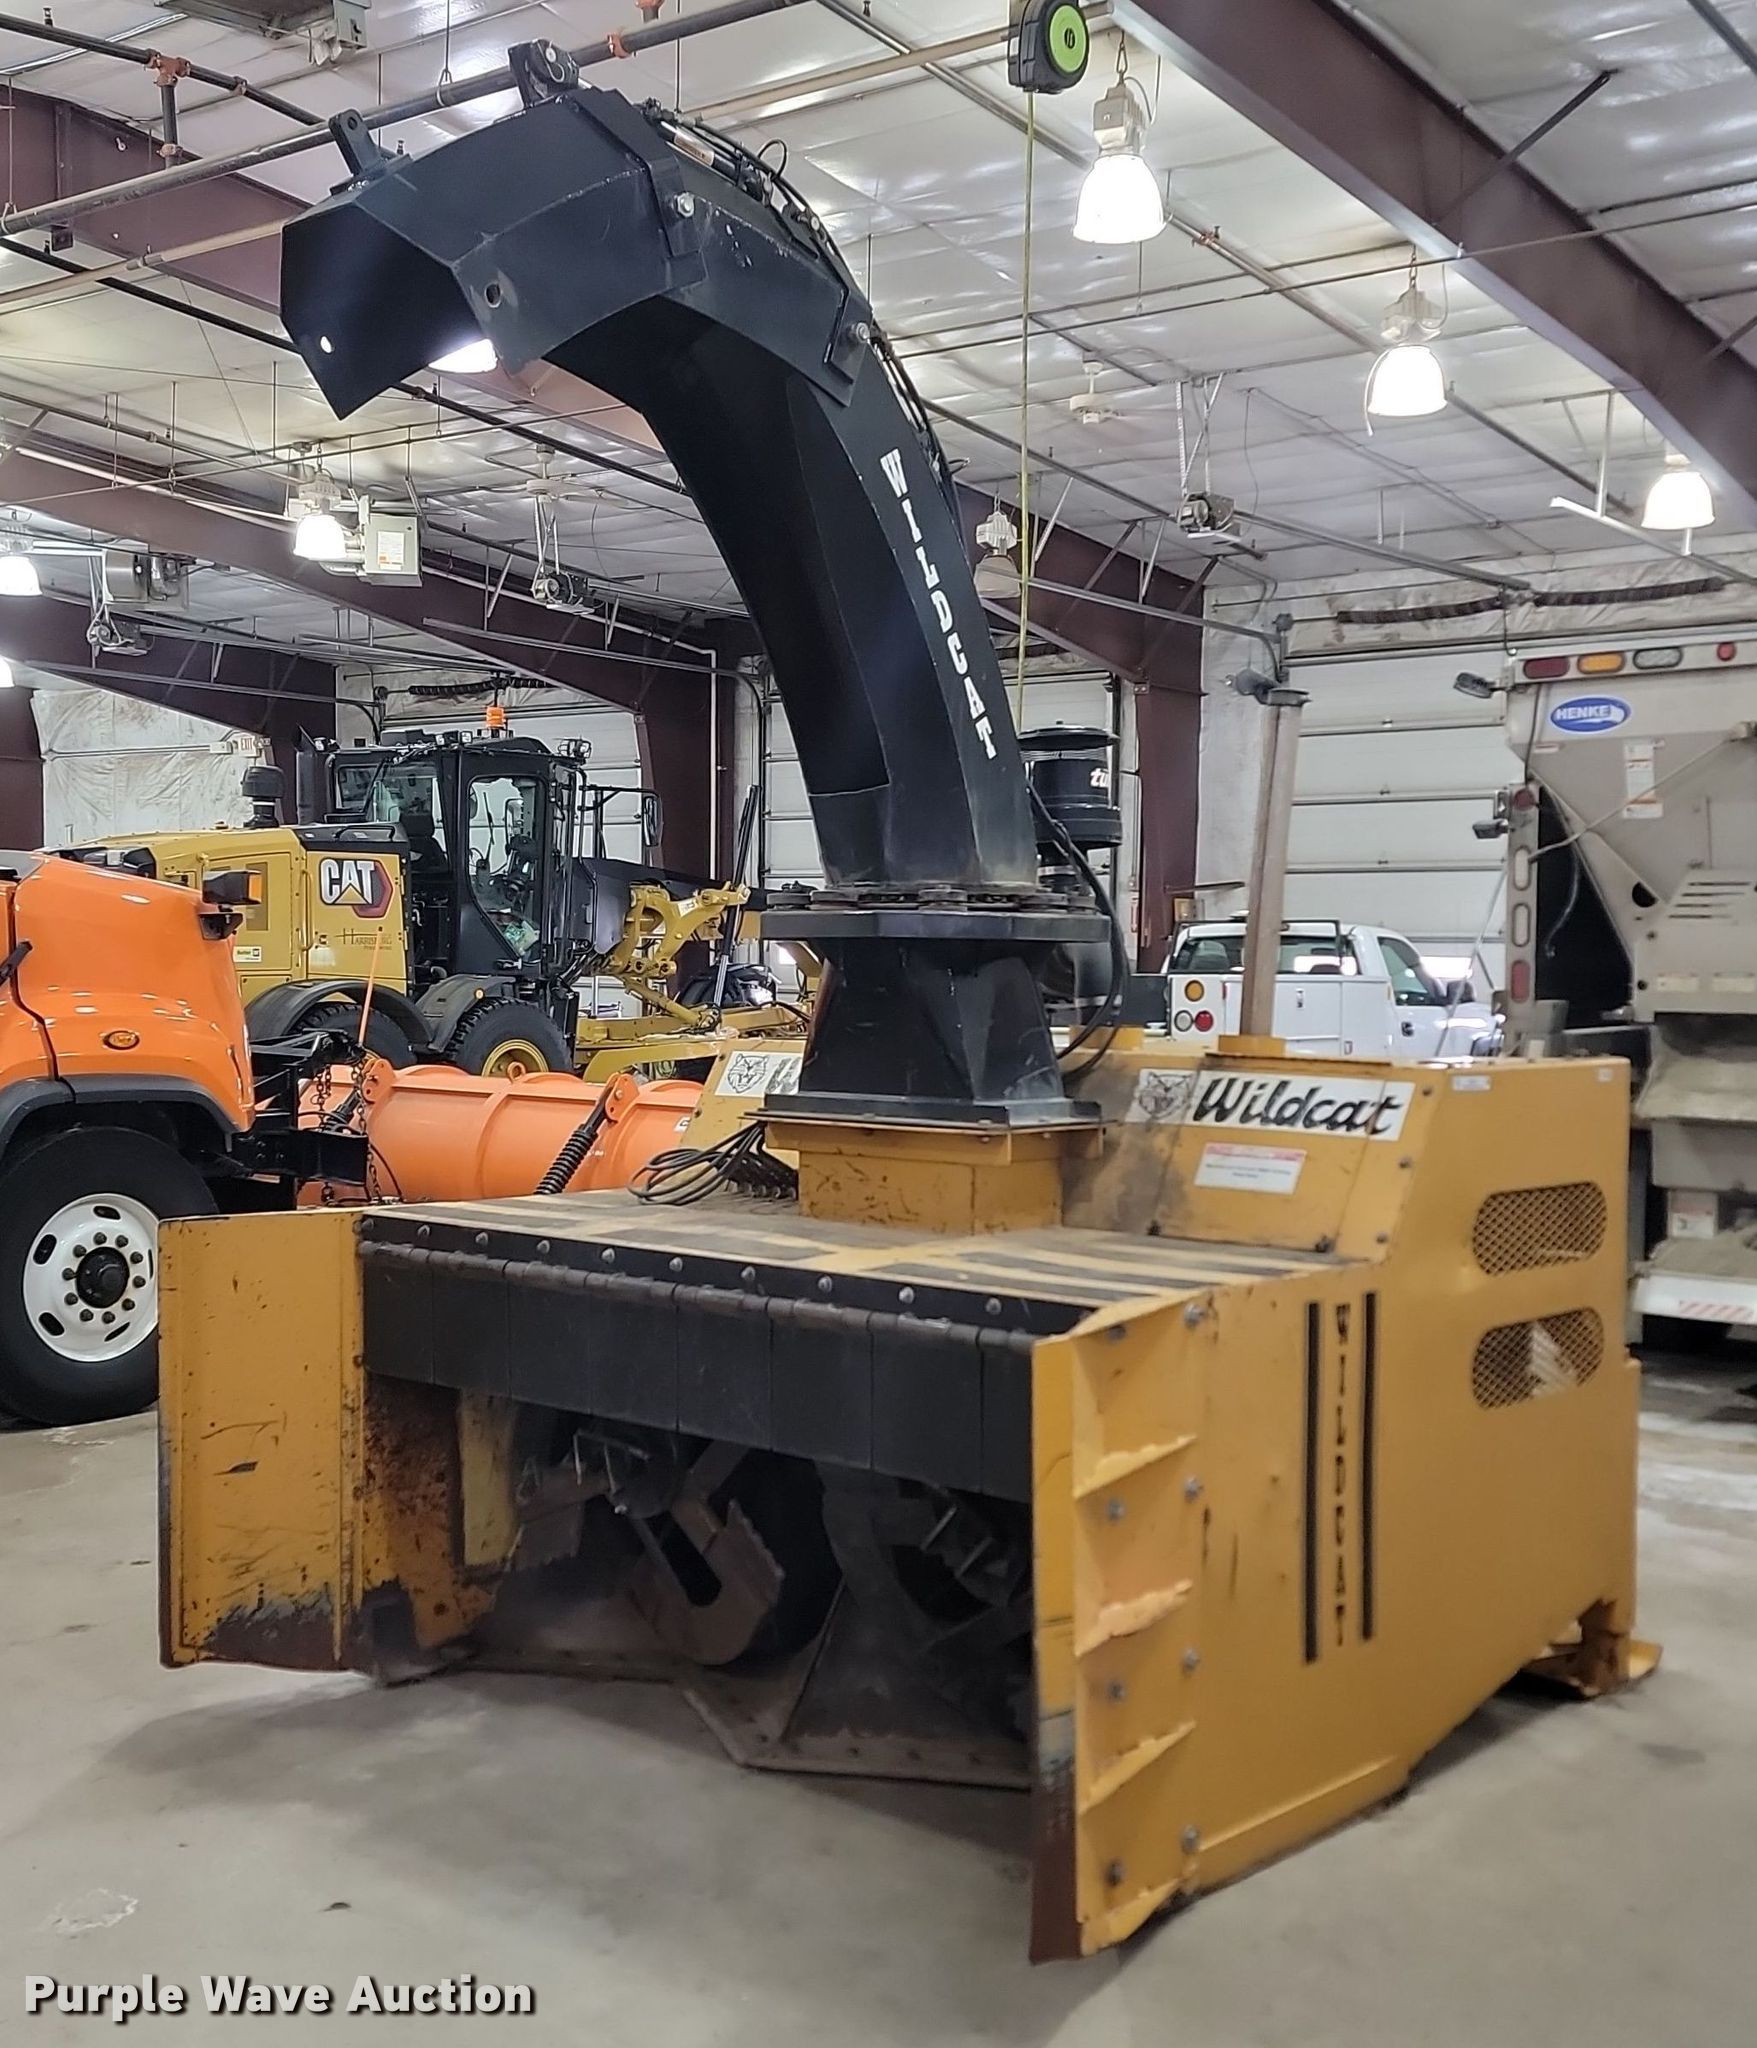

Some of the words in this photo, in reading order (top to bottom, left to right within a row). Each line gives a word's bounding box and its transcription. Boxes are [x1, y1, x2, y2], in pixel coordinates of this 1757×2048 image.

[880, 448, 998, 760] WILDCAT
[1555, 704, 1611, 720] HENKE
[320, 857, 375, 905] CAT
[1193, 1077, 1403, 1135] Wildcat
